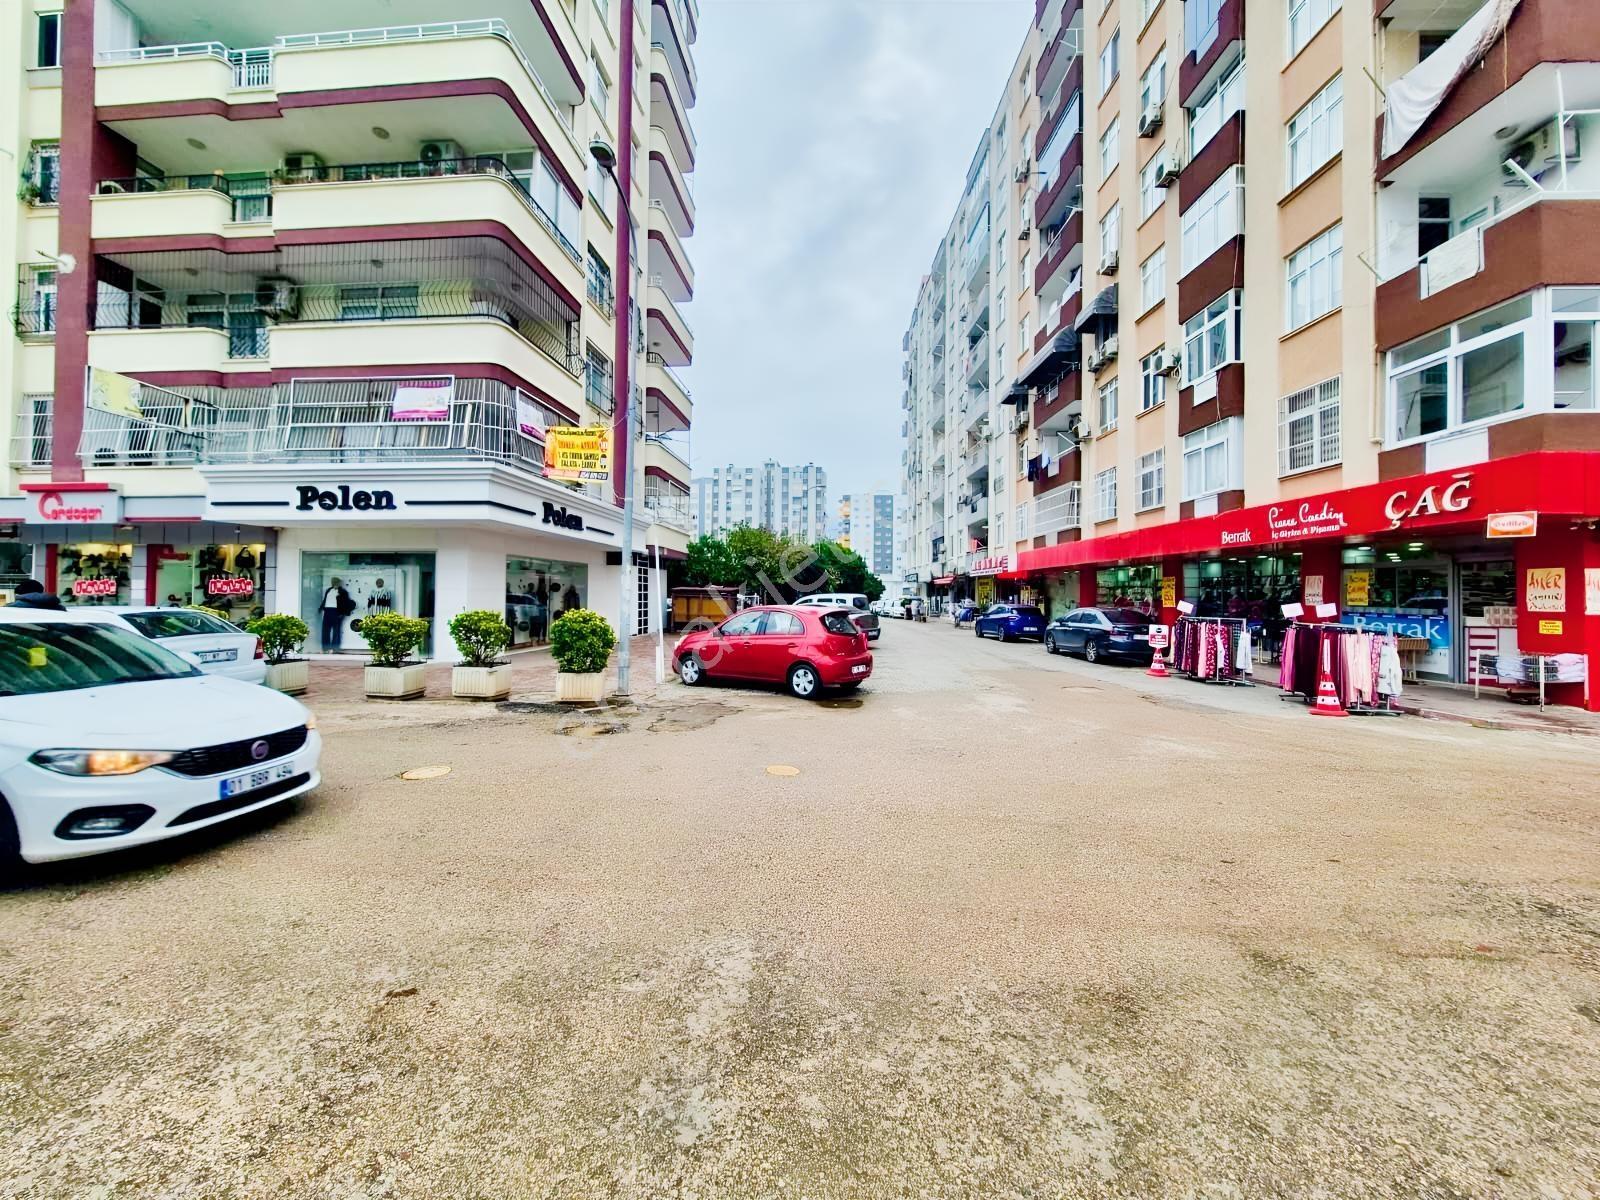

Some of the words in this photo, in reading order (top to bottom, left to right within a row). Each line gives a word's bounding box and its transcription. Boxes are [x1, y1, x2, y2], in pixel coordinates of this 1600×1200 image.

[295, 485, 397, 511] Polen
[1384, 473, 1475, 529] ÇAĞ
[541, 501, 585, 532] Polen
[1268, 506, 1298, 529] Pierre
[1298, 501, 1348, 527] Cardin
[1221, 528, 1252, 545] Berrak
[1353, 615, 1442, 639] Berrak
